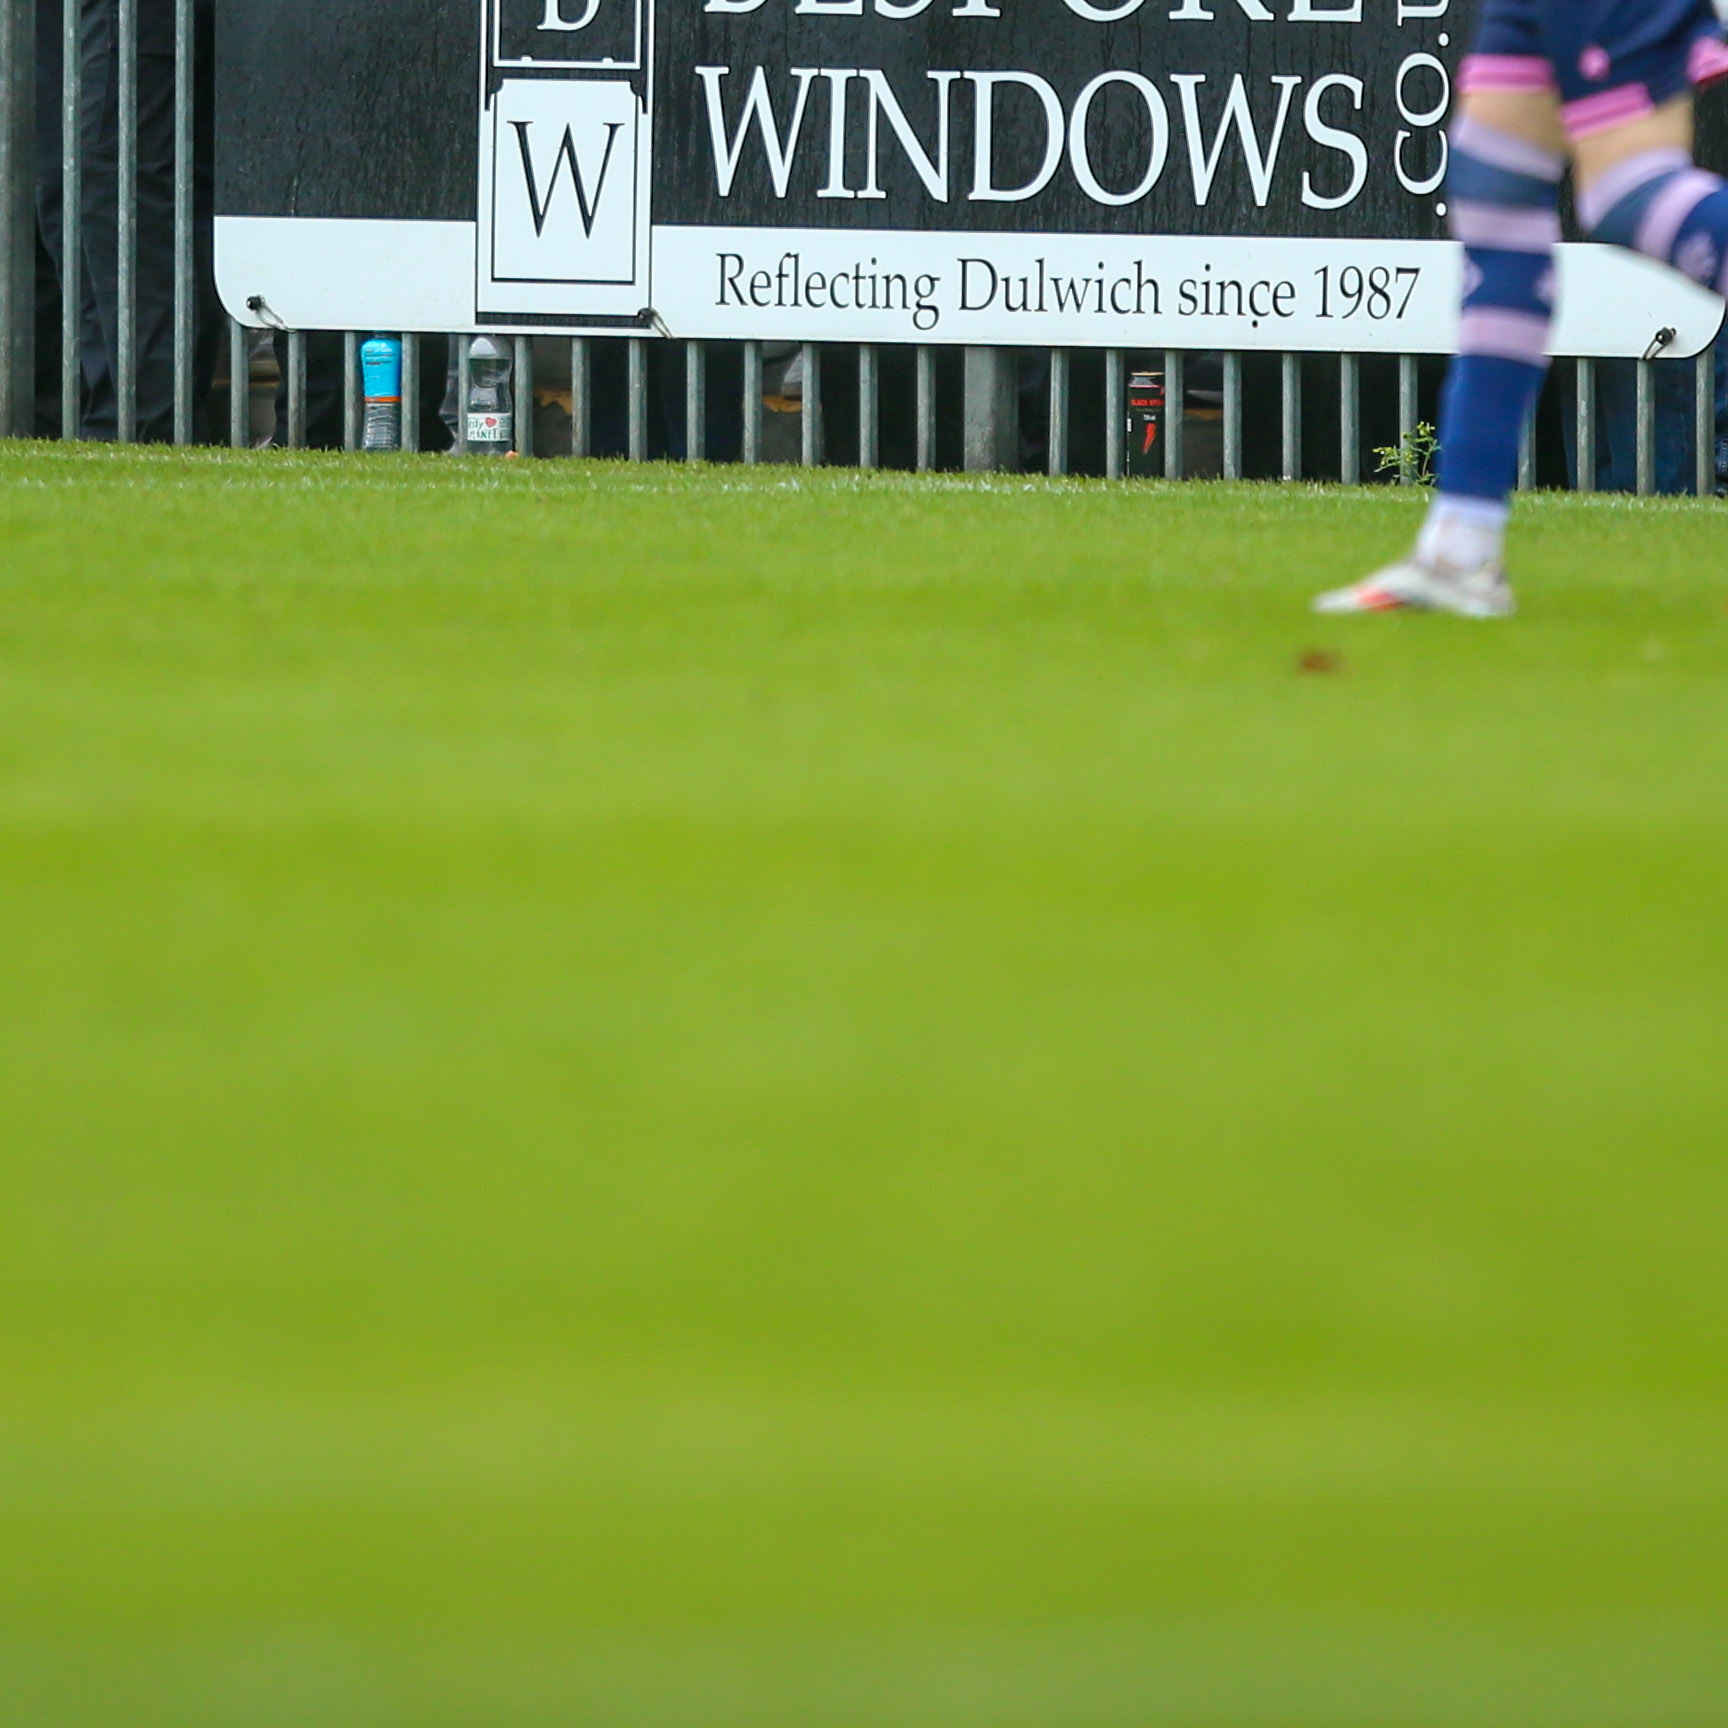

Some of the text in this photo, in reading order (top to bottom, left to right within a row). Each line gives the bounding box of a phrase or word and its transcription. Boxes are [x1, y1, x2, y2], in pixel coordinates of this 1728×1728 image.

[506, 120, 626, 239] W
[693, 64, 1369, 210] WINDOWS
[714, 251, 1422, 331] Reflecting Dulwich since 1987
